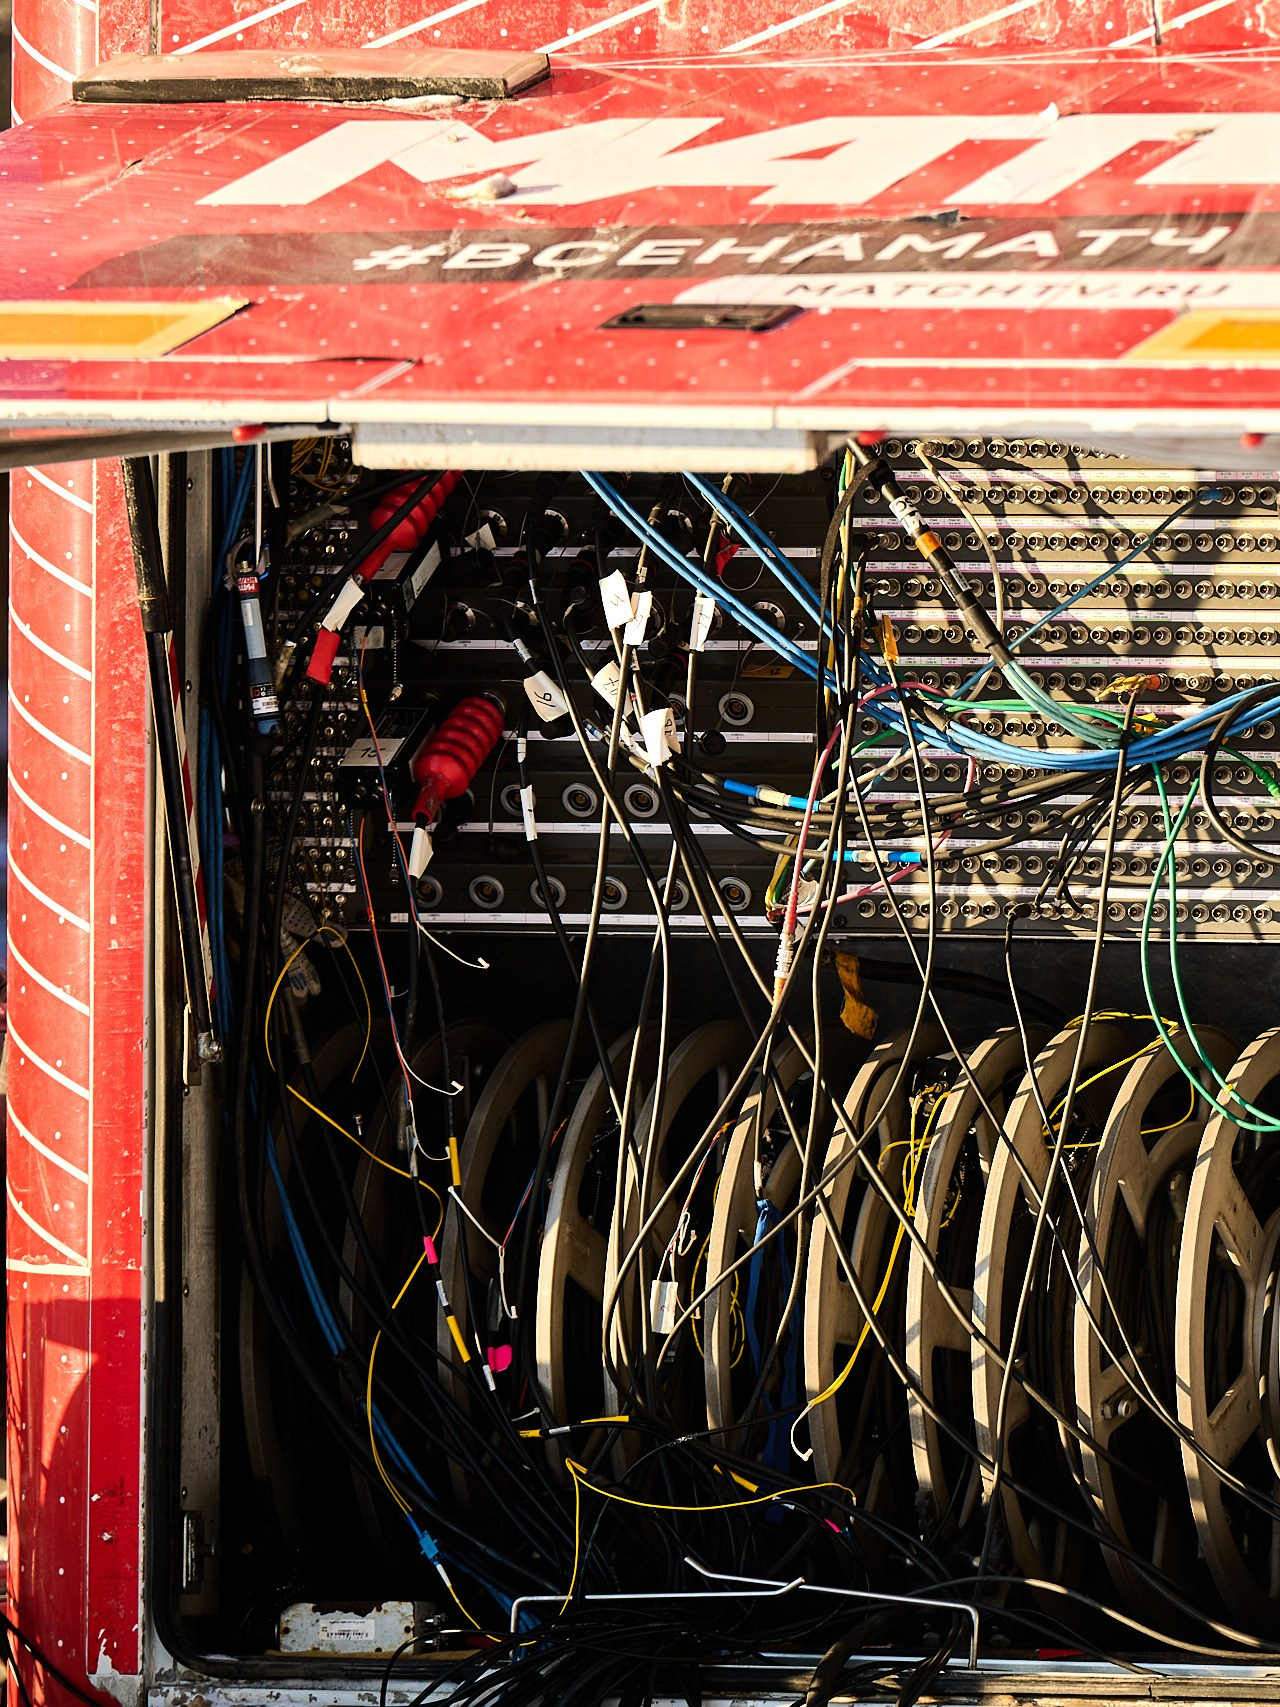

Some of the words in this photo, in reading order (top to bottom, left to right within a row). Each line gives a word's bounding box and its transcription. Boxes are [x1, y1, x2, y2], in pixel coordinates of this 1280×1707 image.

[353, 225, 1231, 271] #ВСЕНАМАТЧ
[785, 281, 1232, 299] MATCHTV.RU
[533, 690, 556, 708] 16
